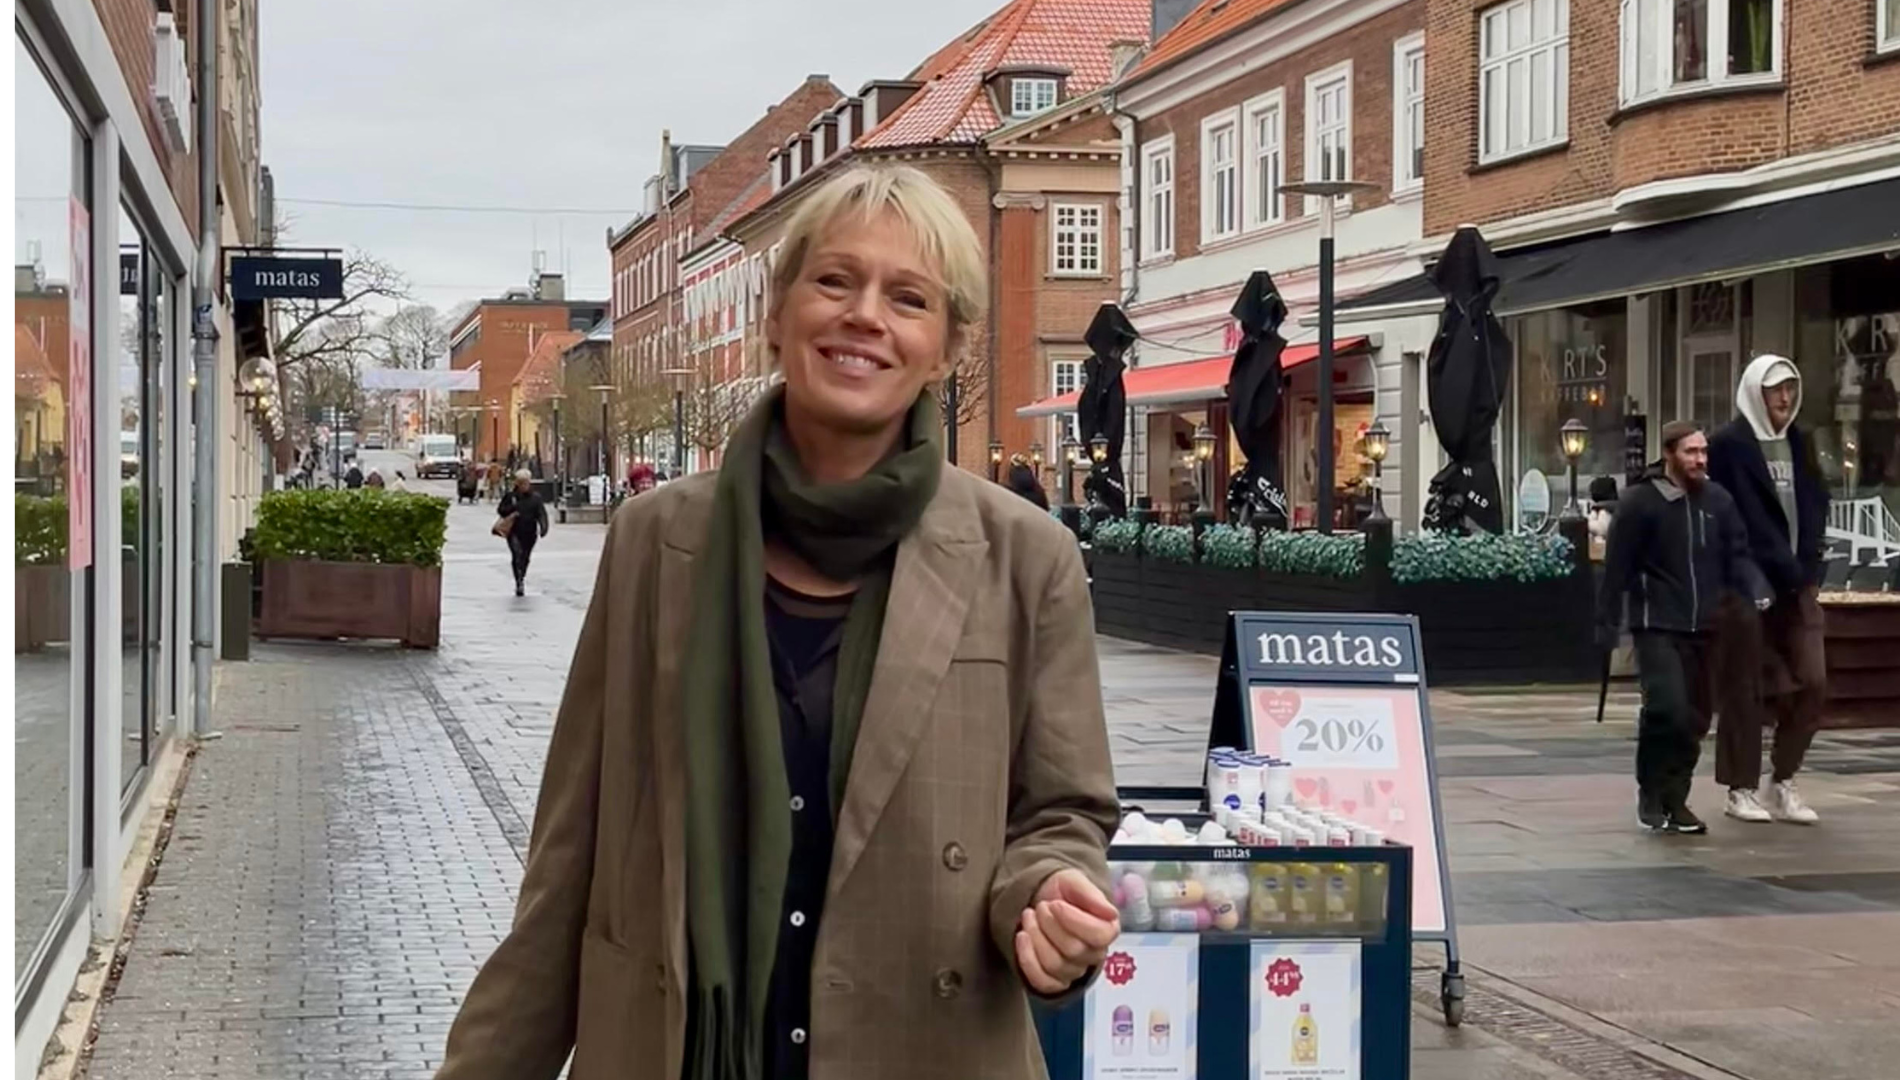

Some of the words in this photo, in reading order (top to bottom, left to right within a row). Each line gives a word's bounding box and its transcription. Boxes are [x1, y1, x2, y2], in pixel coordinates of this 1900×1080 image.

[255, 270, 321, 287] matas
[1540, 344, 1607, 382] KRT'S
[1257, 629, 1403, 667] matas
[1295, 718, 1385, 753] 20%
[1213, 848, 1252, 859] matas
